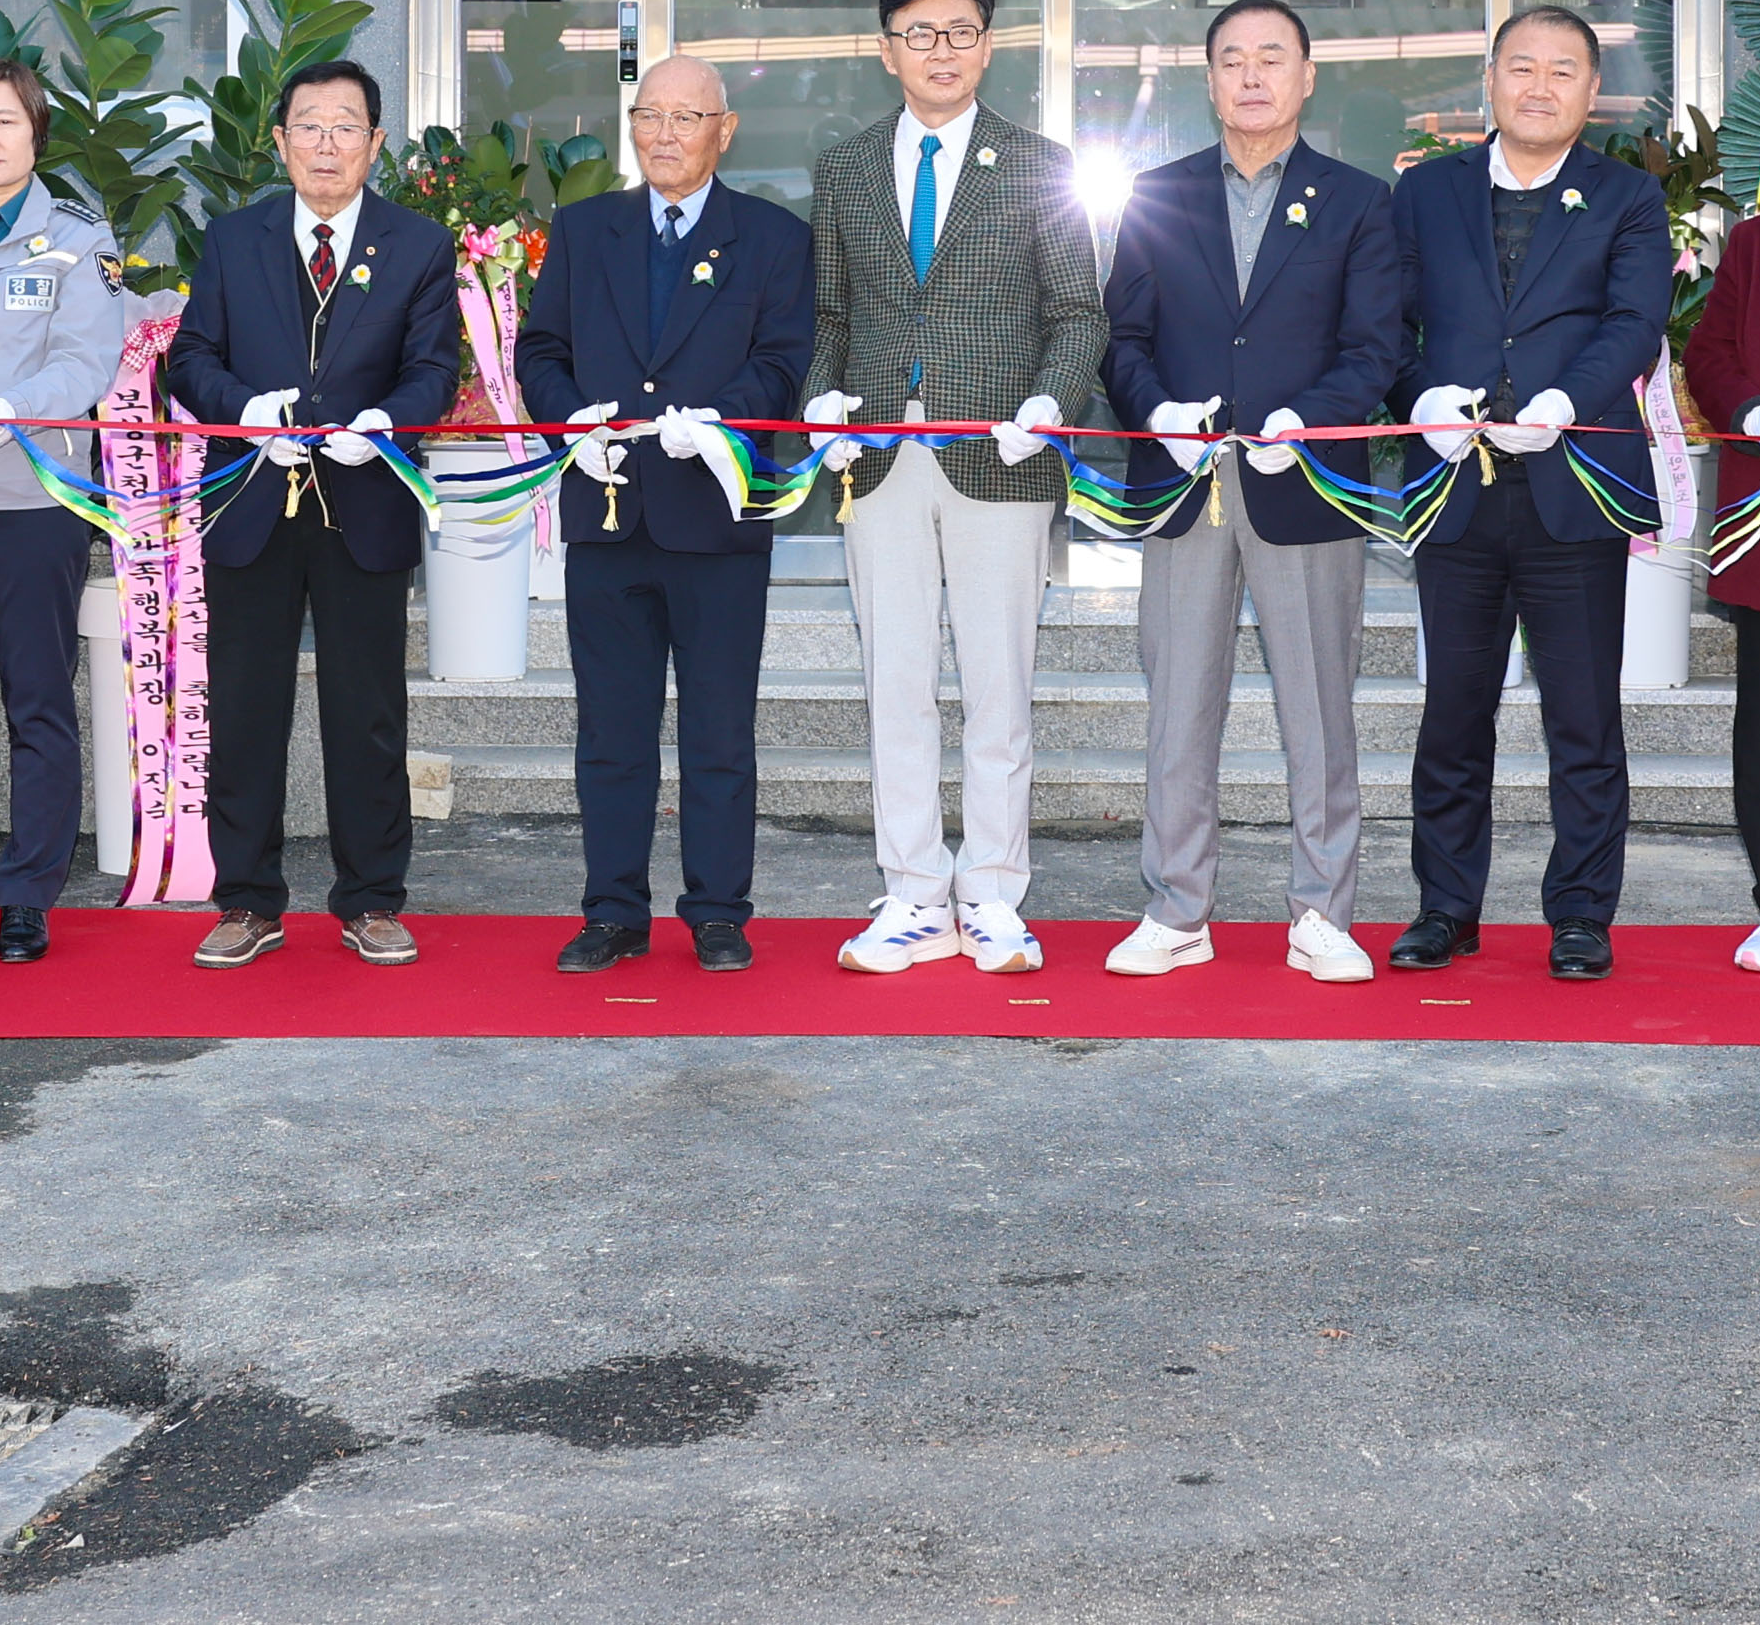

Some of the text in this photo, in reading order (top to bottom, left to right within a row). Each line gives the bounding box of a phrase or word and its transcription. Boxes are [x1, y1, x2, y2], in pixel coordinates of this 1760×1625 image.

[11, 277, 52, 296] 경찰
[10, 297, 50, 308] POLICE
[497, 264, 515, 377] 성군노인회
